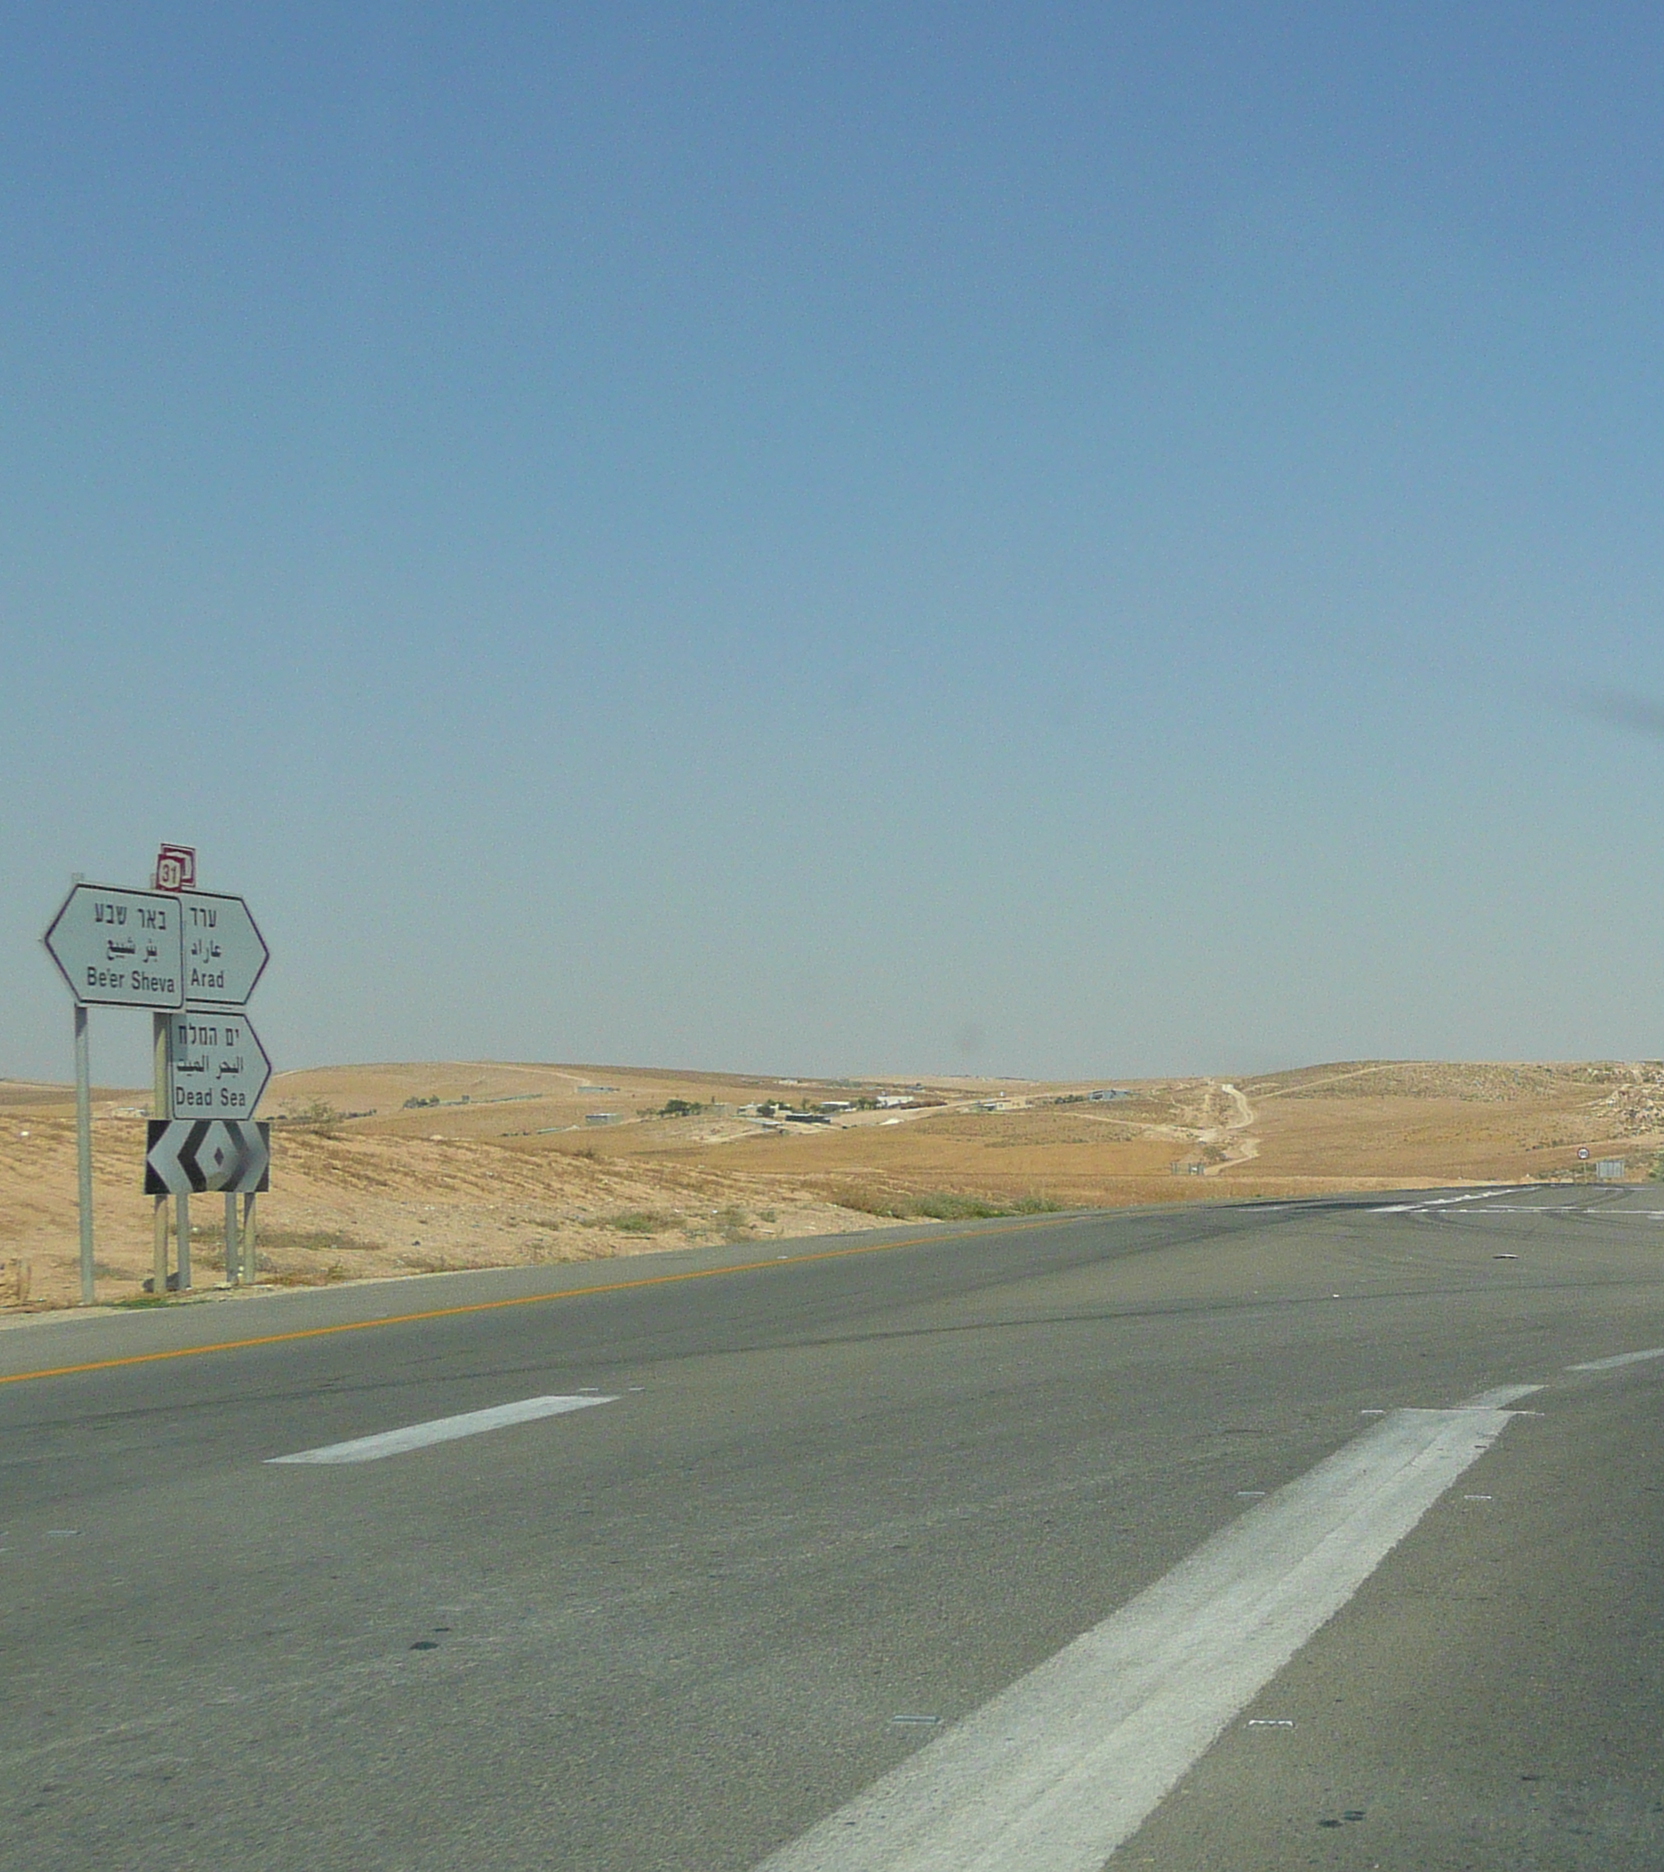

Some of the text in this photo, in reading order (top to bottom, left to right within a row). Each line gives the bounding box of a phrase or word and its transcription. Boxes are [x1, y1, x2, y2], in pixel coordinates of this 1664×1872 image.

[162, 864, 177, 885] 31
[95, 903, 166, 930] באר שבע
[189, 907, 217, 928] ערד
[87, 966, 175, 993] Be'er Sheva
[190, 968, 224, 989] Arad
[178, 1023, 240, 1047] ים המלח
[175, 1086, 246, 1107] Dead Sea
